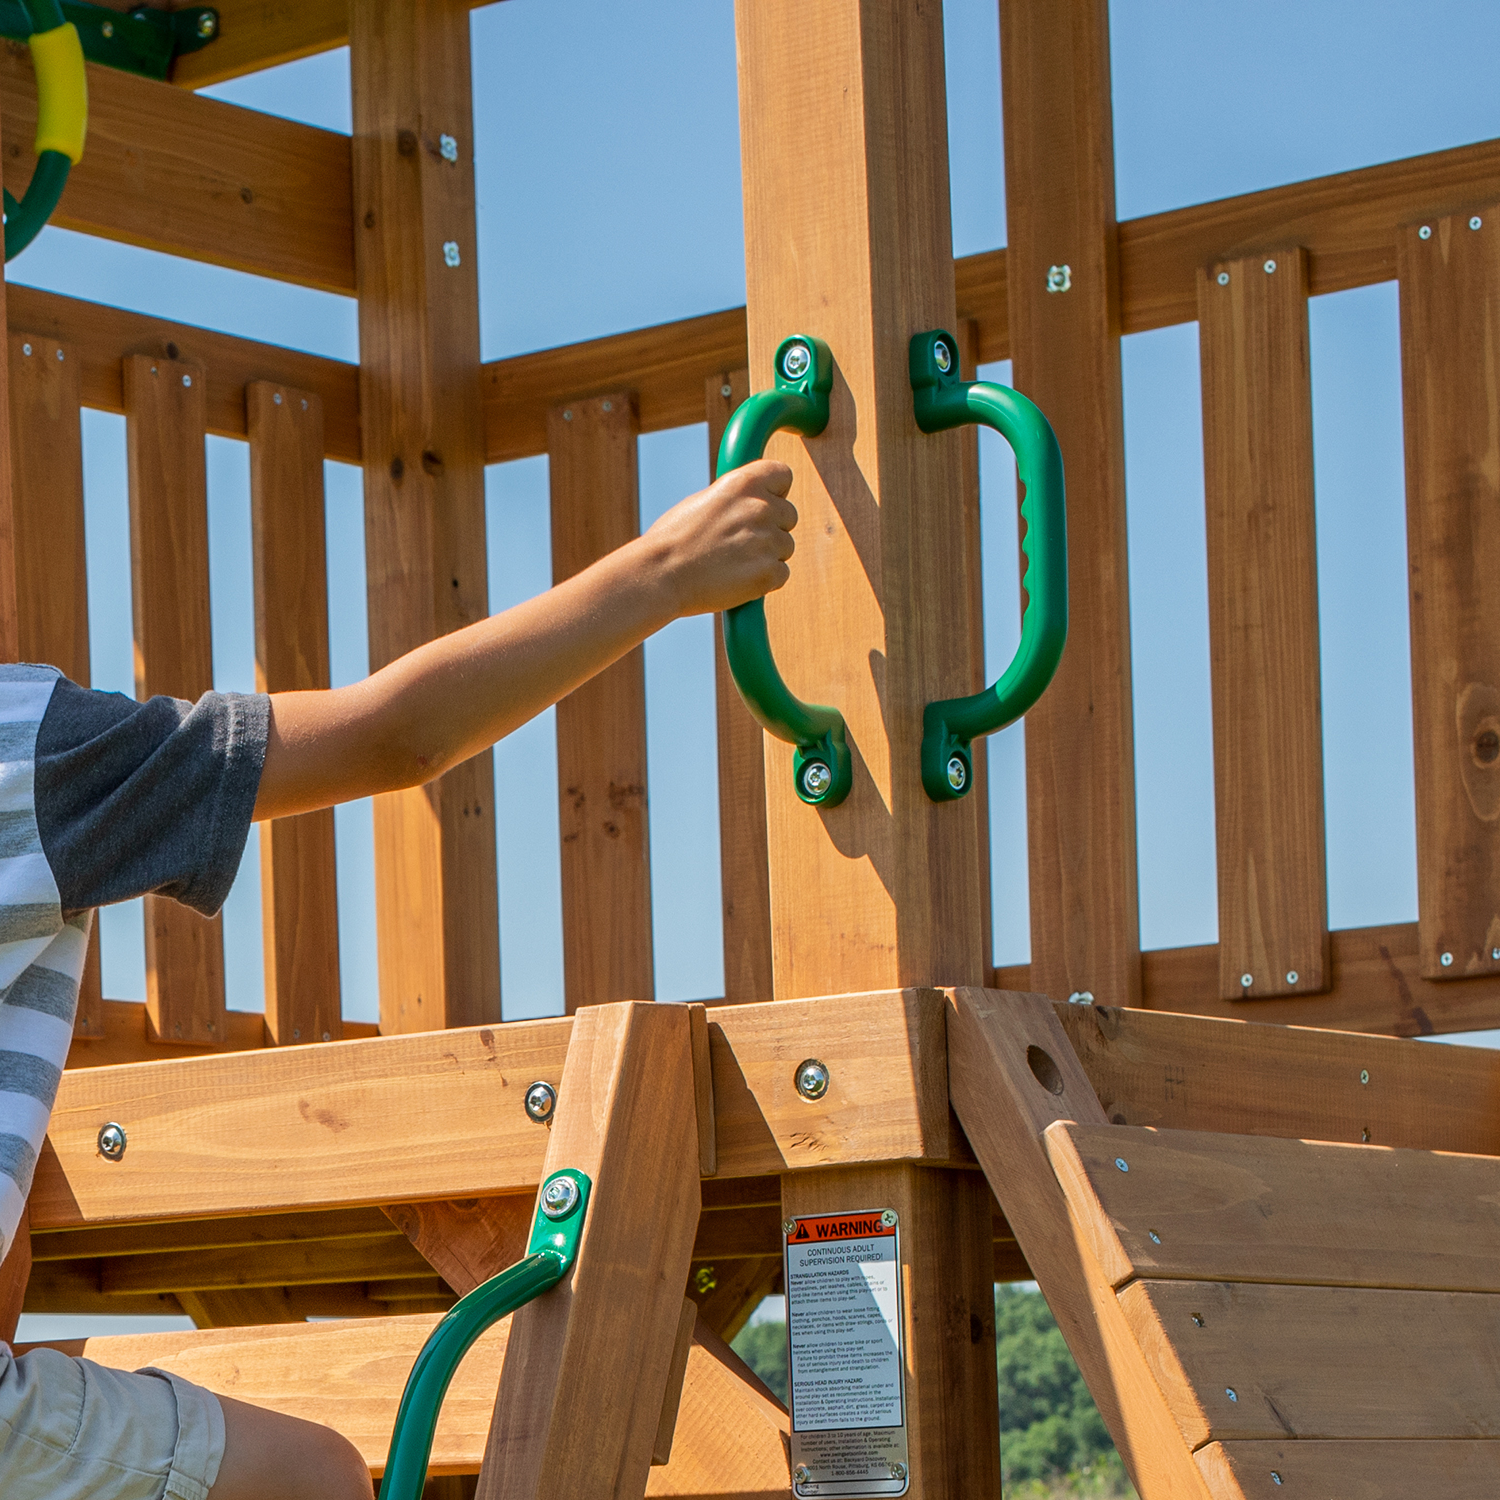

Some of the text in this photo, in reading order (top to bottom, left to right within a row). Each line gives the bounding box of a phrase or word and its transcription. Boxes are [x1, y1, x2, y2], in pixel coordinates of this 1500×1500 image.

[816, 1219, 883, 1238] WARNING
[808, 1244, 874, 1256] CONTINUOUS ADULT
[800, 1254, 883, 1267] SUPERVISION REQUIRED!
[790, 1271, 827, 1279] STRANGULATION
